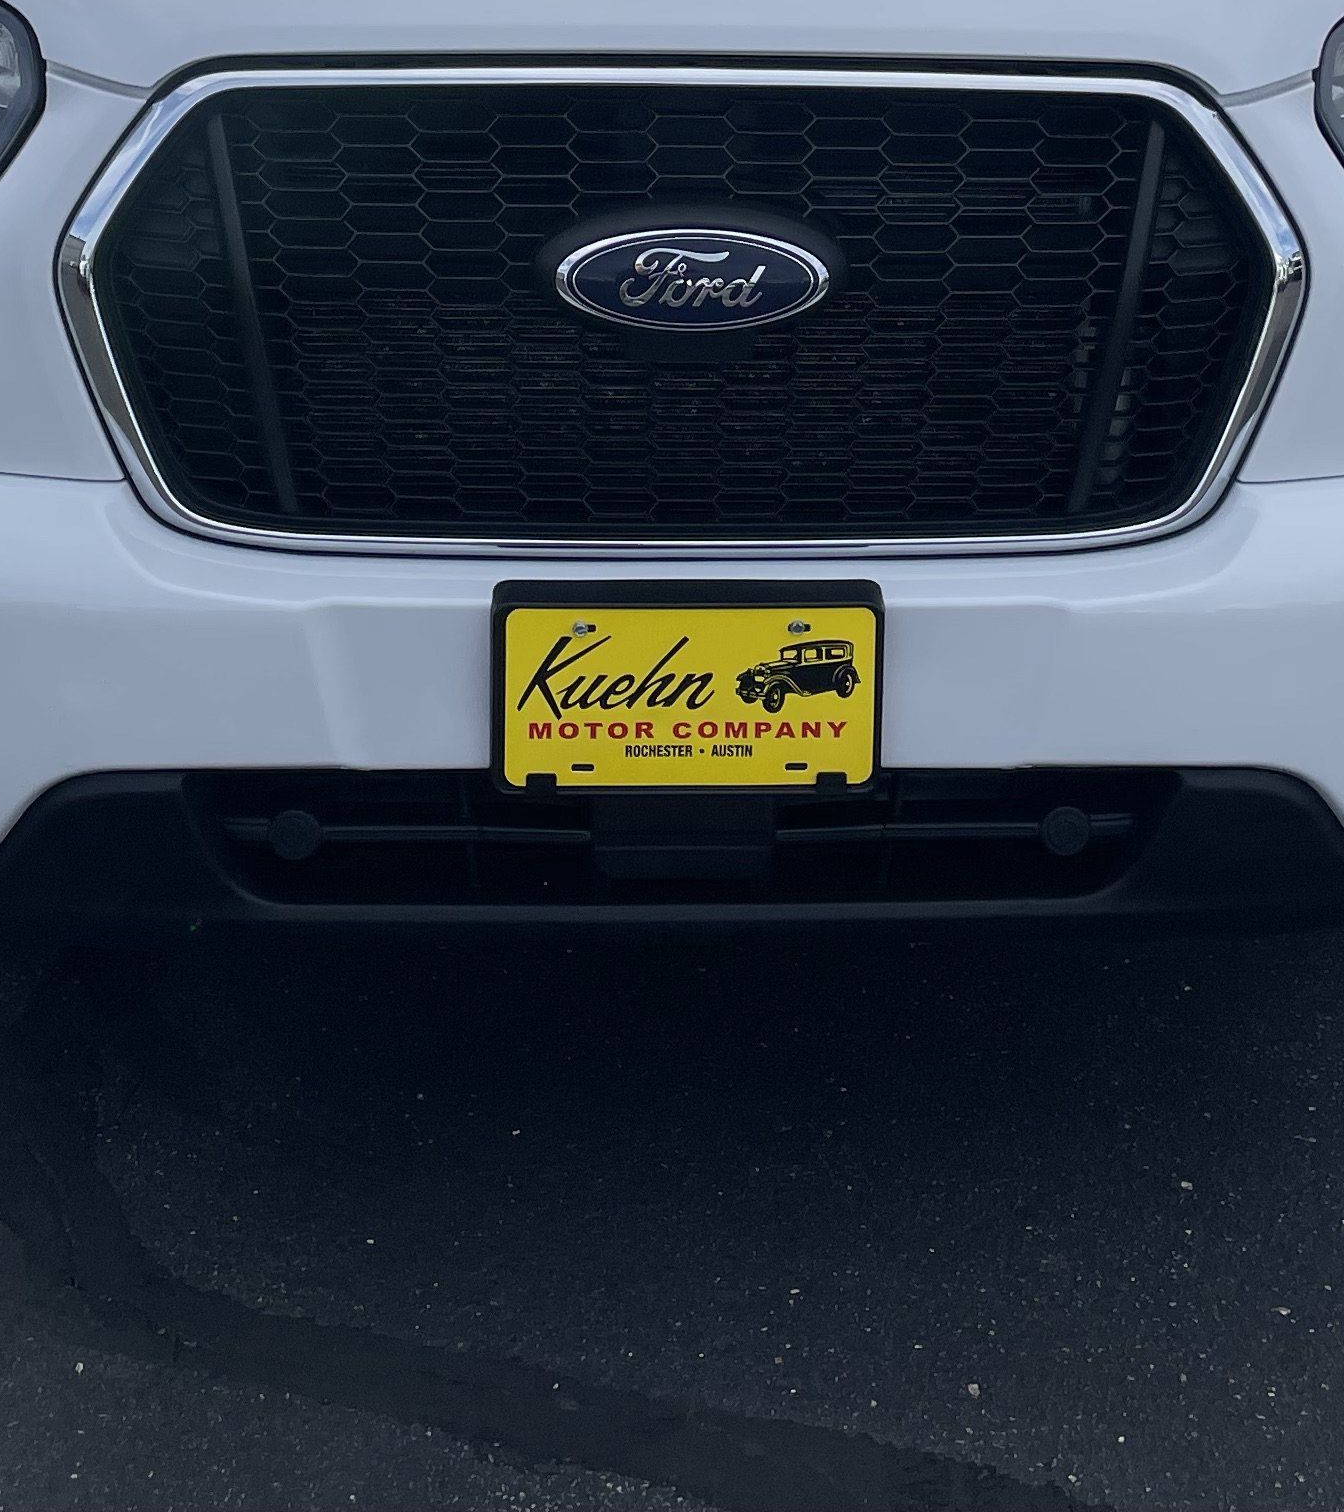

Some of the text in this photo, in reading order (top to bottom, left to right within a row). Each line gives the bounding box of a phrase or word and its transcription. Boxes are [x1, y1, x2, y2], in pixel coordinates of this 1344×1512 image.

[619, 247, 766, 308] Ford
[516, 635, 715, 720] Kuehn
[528, 720, 848, 740] MOTOR COMPANY
[624, 743, 754, 758] ROCHESTER AUSTIN
